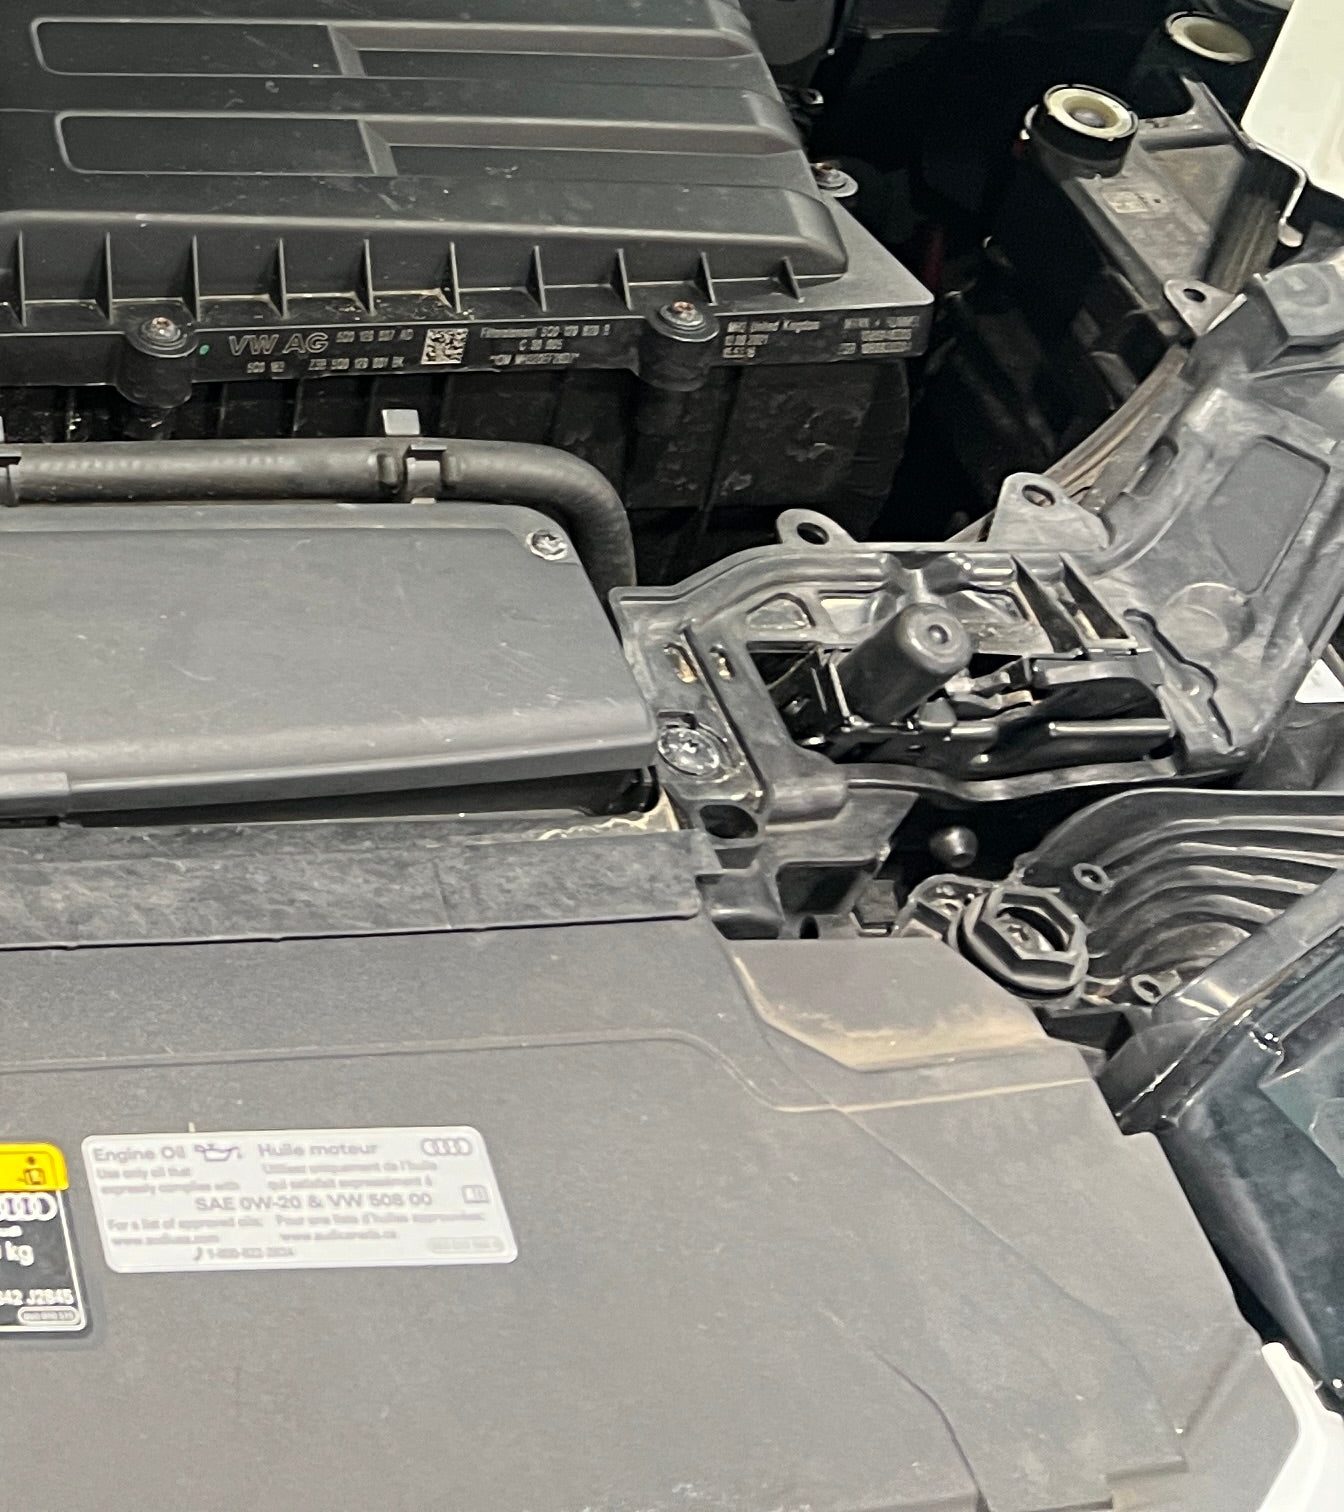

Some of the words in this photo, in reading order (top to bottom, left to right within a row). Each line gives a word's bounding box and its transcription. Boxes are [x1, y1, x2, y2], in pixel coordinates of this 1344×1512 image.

[228, 334, 279, 356] VW
[282, 332, 329, 354] AG
[93, 1148, 155, 1163] Engine
[161, 1146, 186, 1159] Oil
[258, 1144, 304, 1156] Huile
[310, 1144, 377, 1155] moteur
[195, 1197, 236, 1211] SAE
[240, 1194, 301, 1210] 0W-20
[327, 1194, 362, 1207] VW
[369, 1194, 404, 1207] 508
[409, 1193, 433, 1206] 00
[5, 1240, 34, 1266] kg
